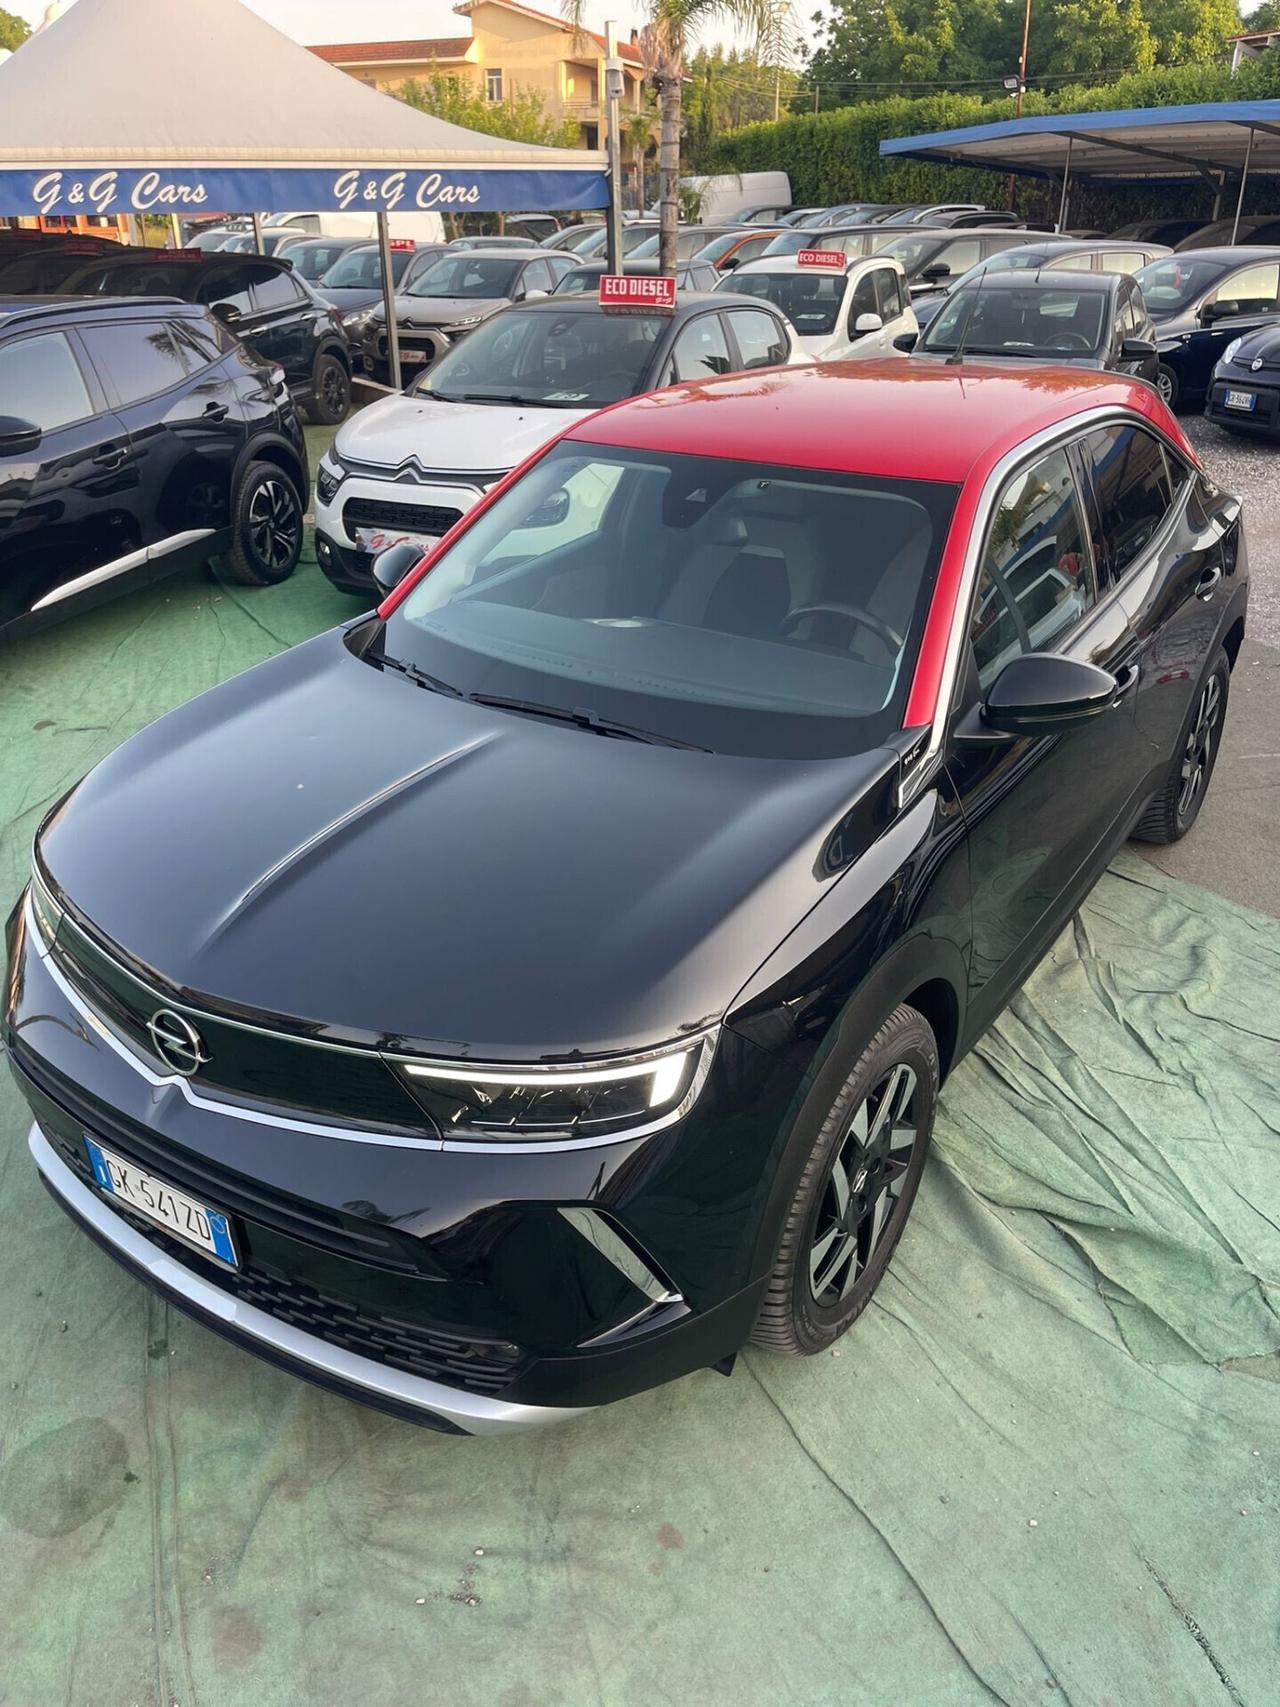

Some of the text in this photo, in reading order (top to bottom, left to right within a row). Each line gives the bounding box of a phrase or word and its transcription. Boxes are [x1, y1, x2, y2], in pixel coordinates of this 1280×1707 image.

[131, 172, 208, 210] Cars
[416, 173, 480, 208] Cars
[800, 253, 814, 262] ECO
[815, 254, 838, 264] DIESEL
[605, 278, 670, 297] ECO DIESEL
